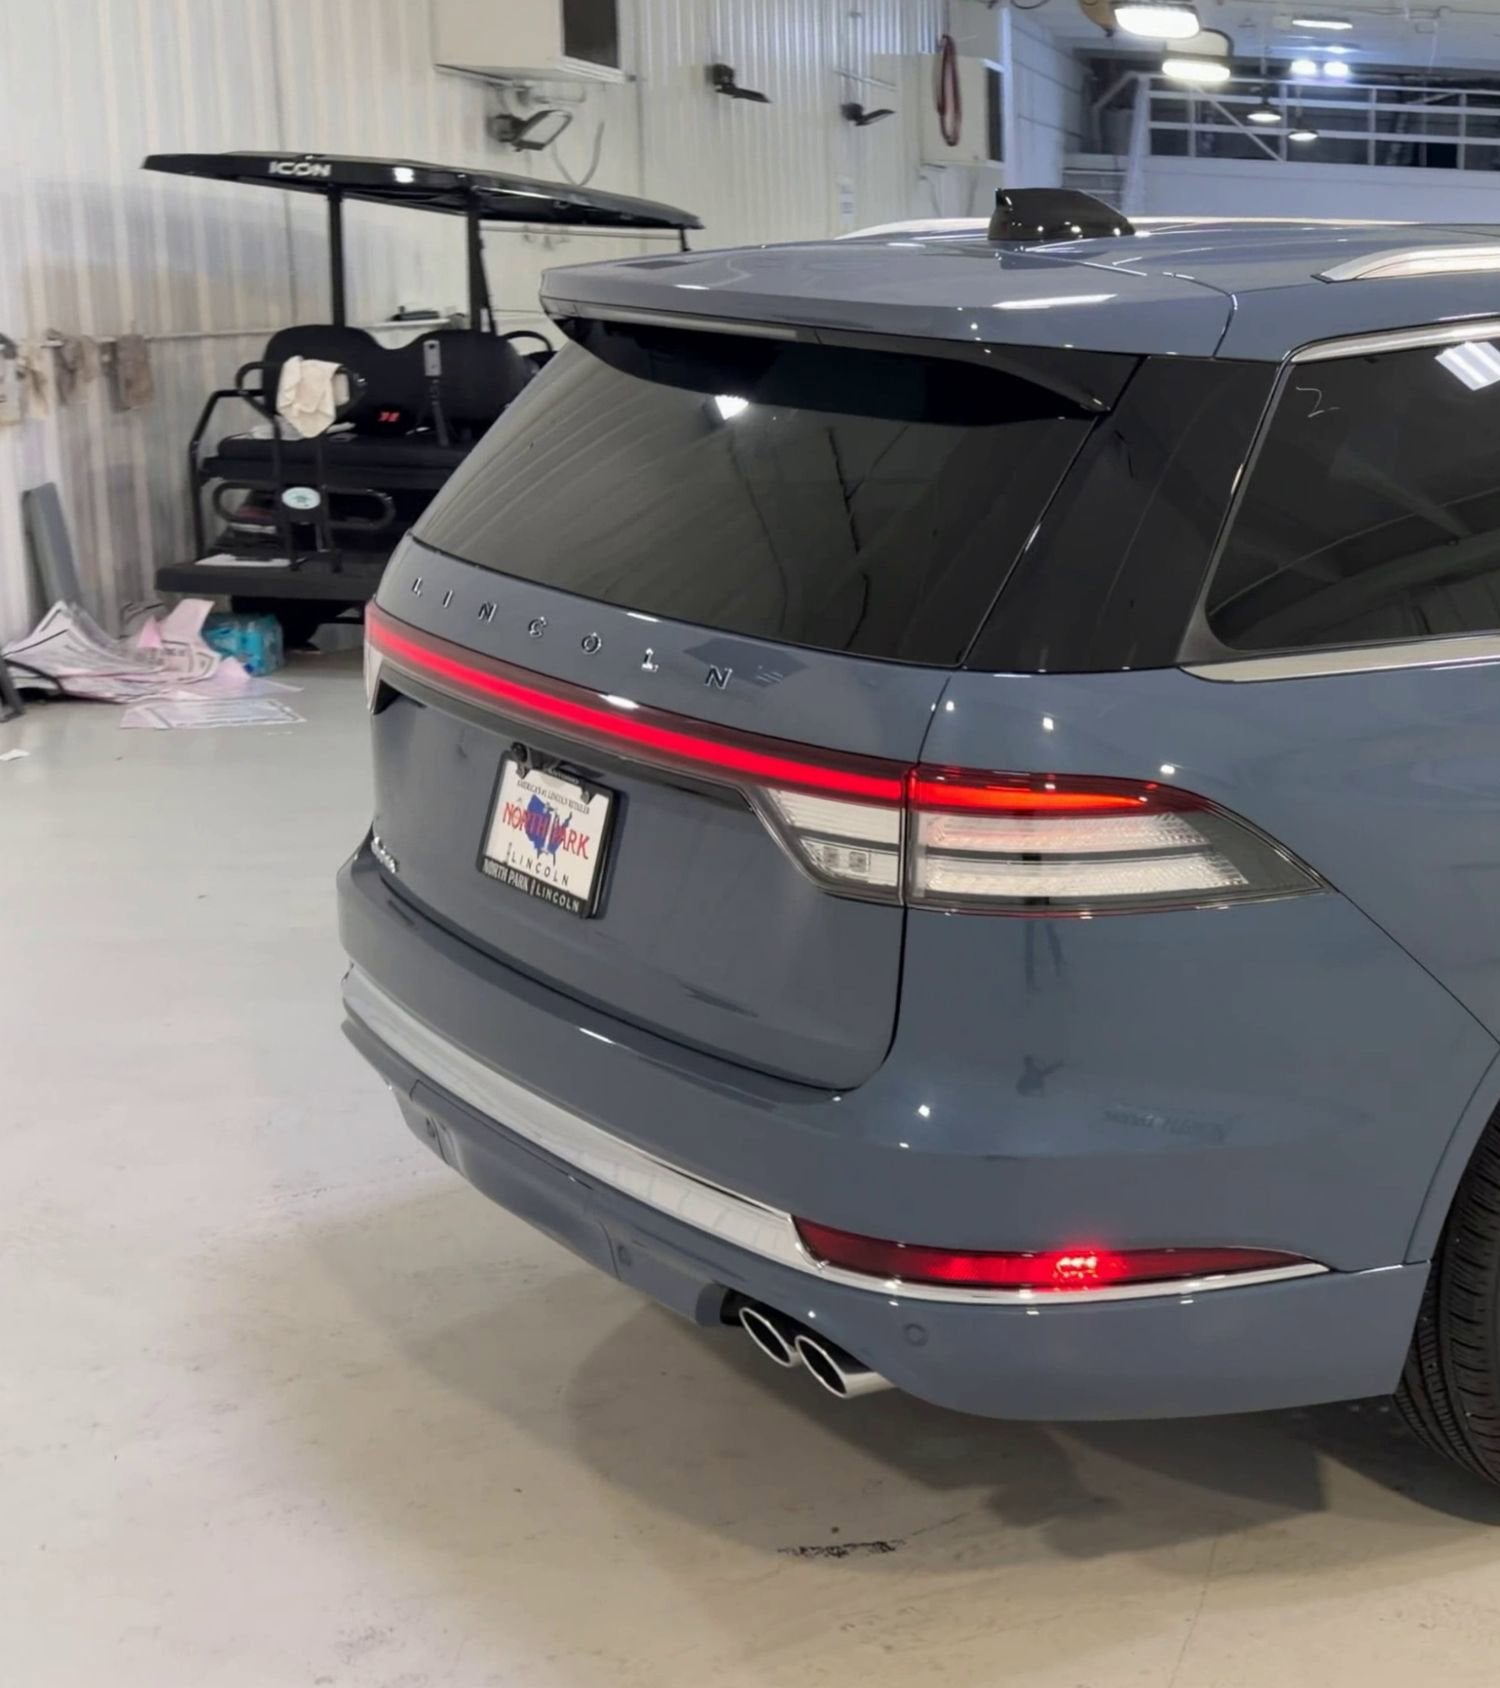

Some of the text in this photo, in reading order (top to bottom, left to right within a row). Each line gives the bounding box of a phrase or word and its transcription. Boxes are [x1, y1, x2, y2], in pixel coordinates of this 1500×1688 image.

[268, 160, 332, 177] ICON
[411, 576, 733, 690] LINCOLN
[502, 801, 590, 860] NORTH PARK
[511, 851, 569, 887] LINCOLN
[507, 870, 529, 892] PARK
[535, 883, 581, 912] LINCOLN
